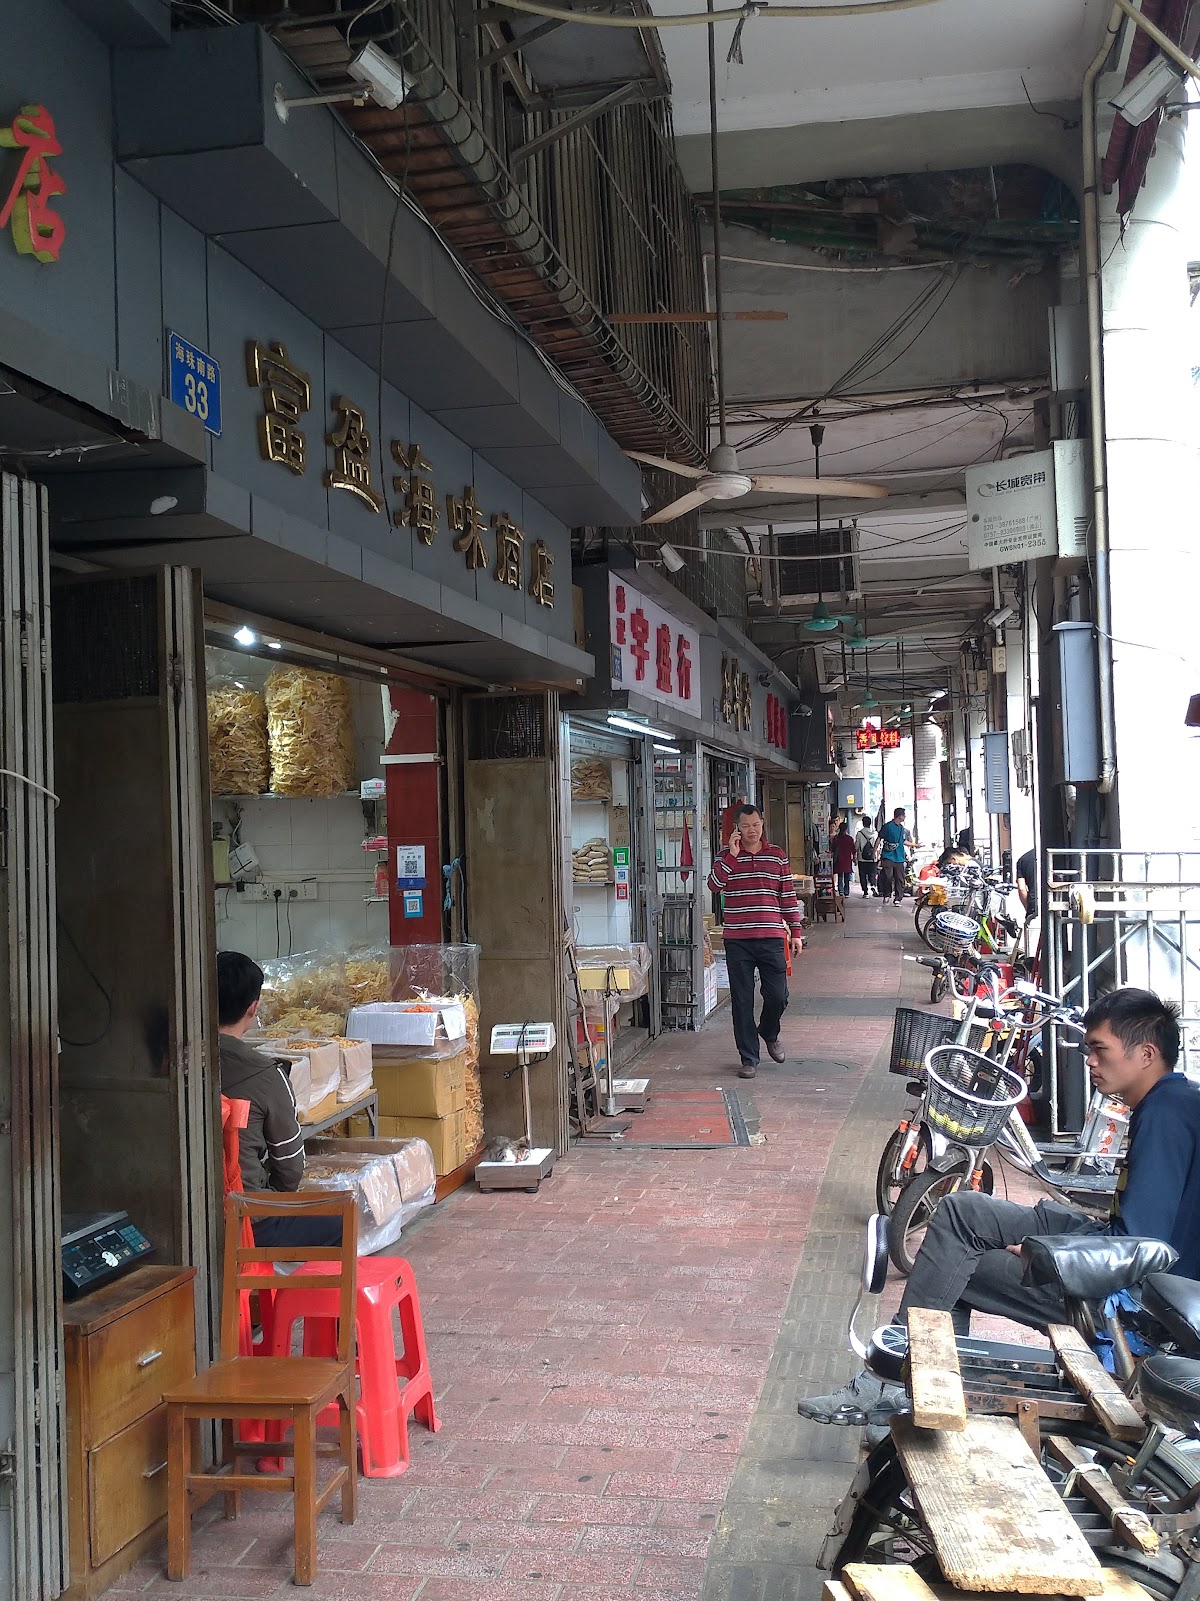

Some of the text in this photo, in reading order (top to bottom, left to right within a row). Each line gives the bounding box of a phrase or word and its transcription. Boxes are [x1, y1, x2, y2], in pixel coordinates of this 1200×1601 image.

[0, 103, 68, 264] 店
[175, 341, 216, 384] 海珠南路
[184, 372, 209, 421] 33
[245, 339, 556, 610] 富盈海味商店
[996, 471, 1046, 492] 长城宽带
